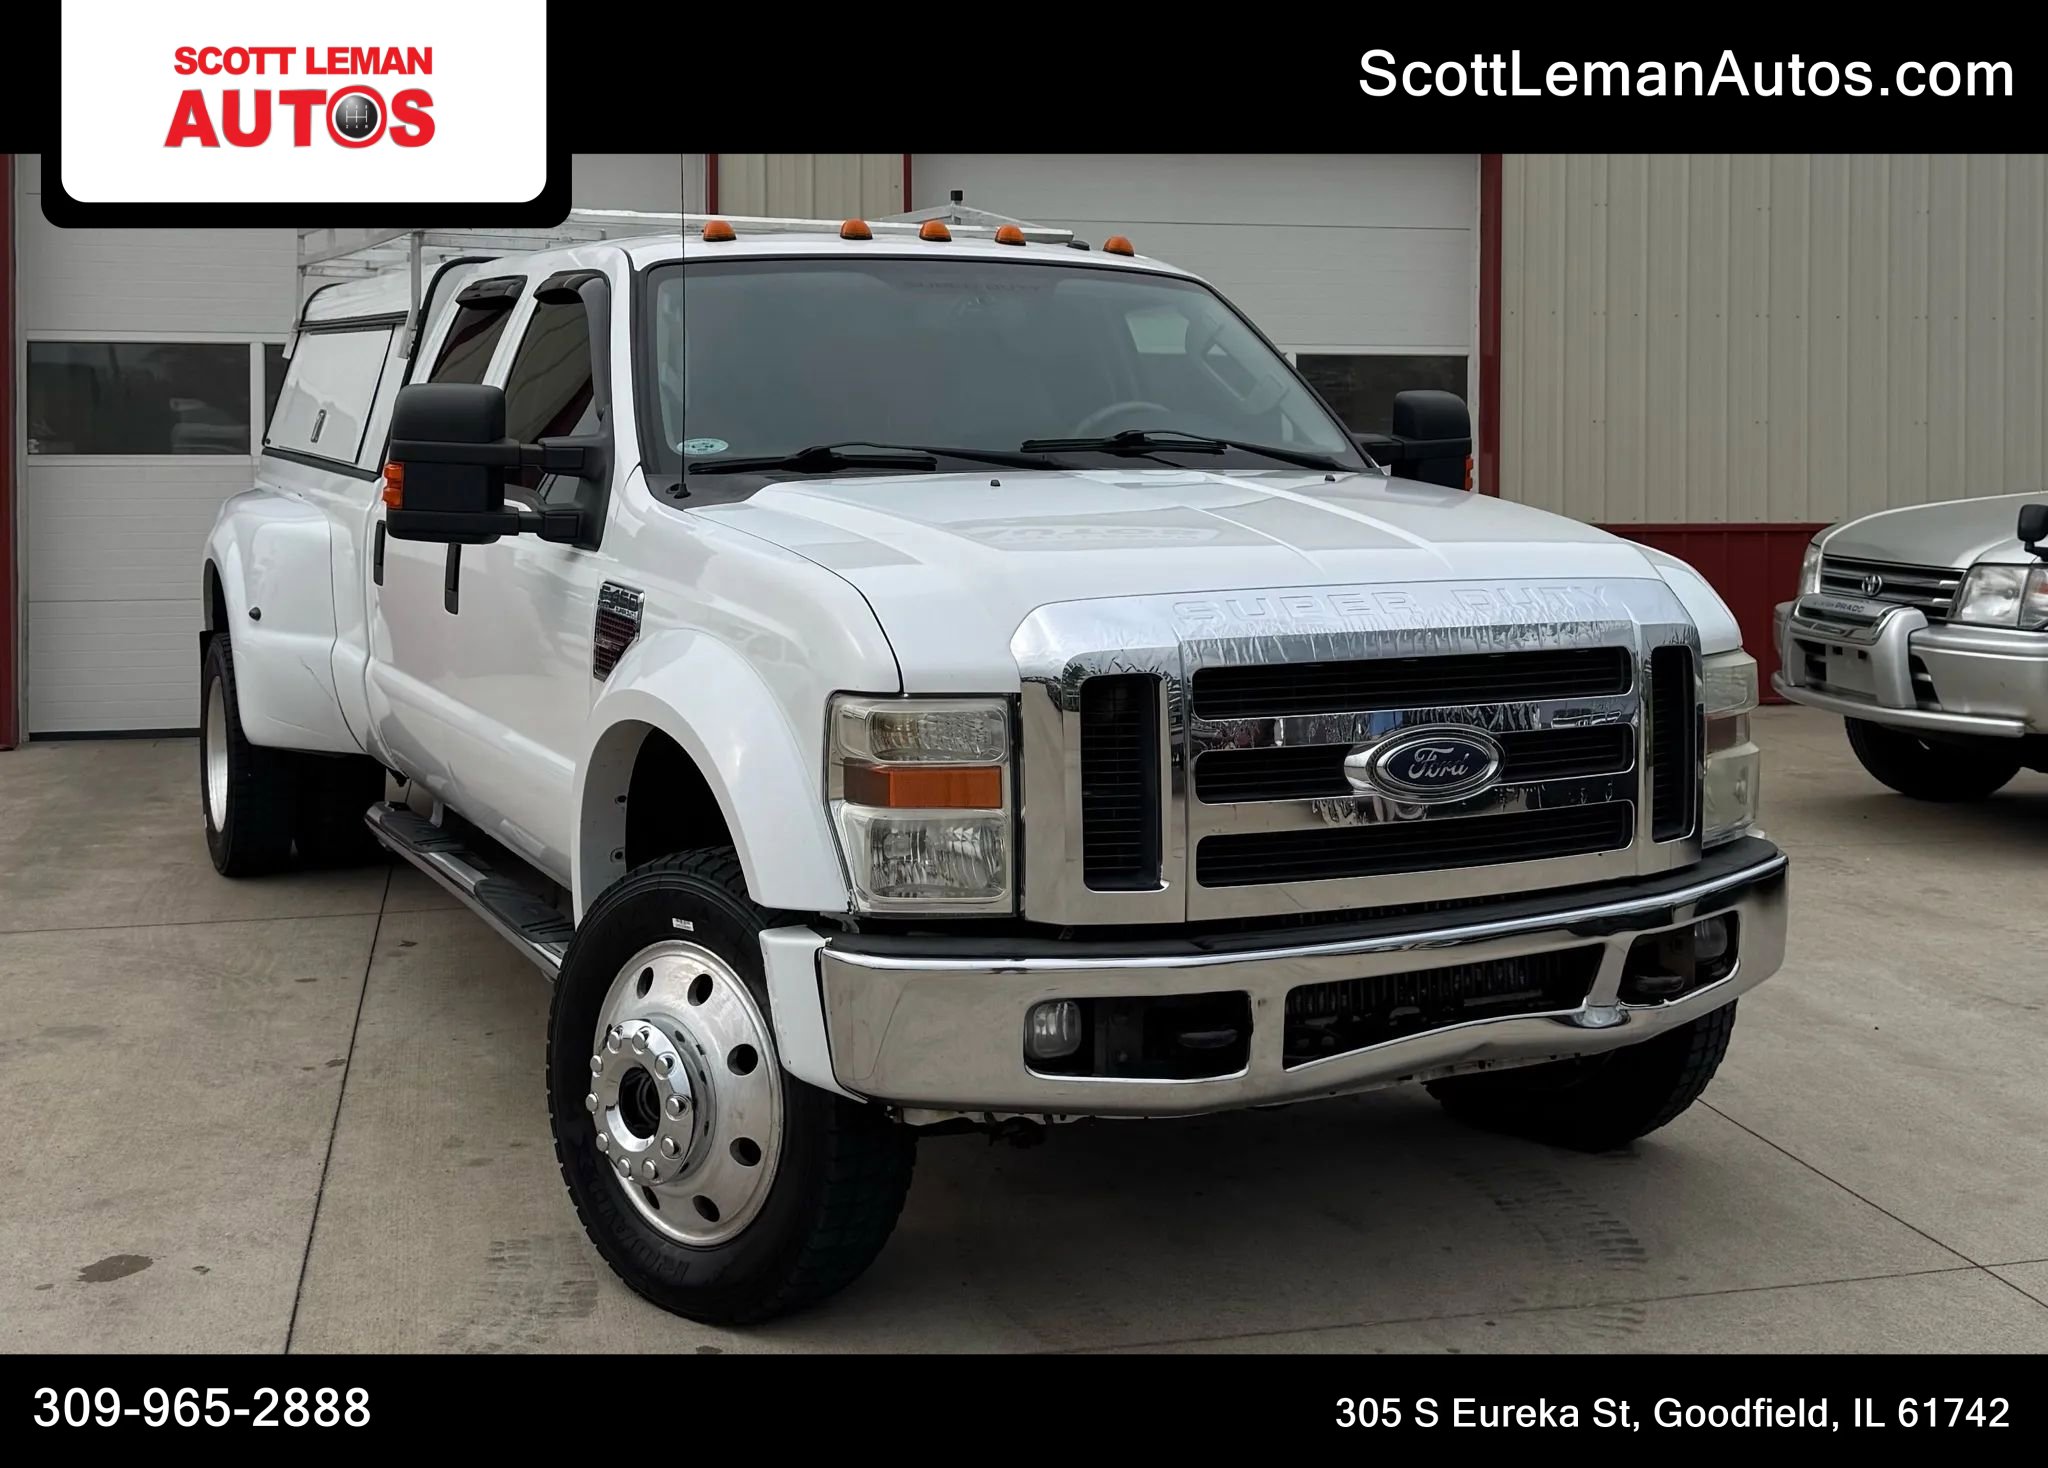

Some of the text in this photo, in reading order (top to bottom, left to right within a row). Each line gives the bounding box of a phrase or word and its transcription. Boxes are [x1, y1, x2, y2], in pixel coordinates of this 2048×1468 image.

[1172, 584, 1608, 624] SUPER DUTY
[1407, 747, 1469, 779] Ford
